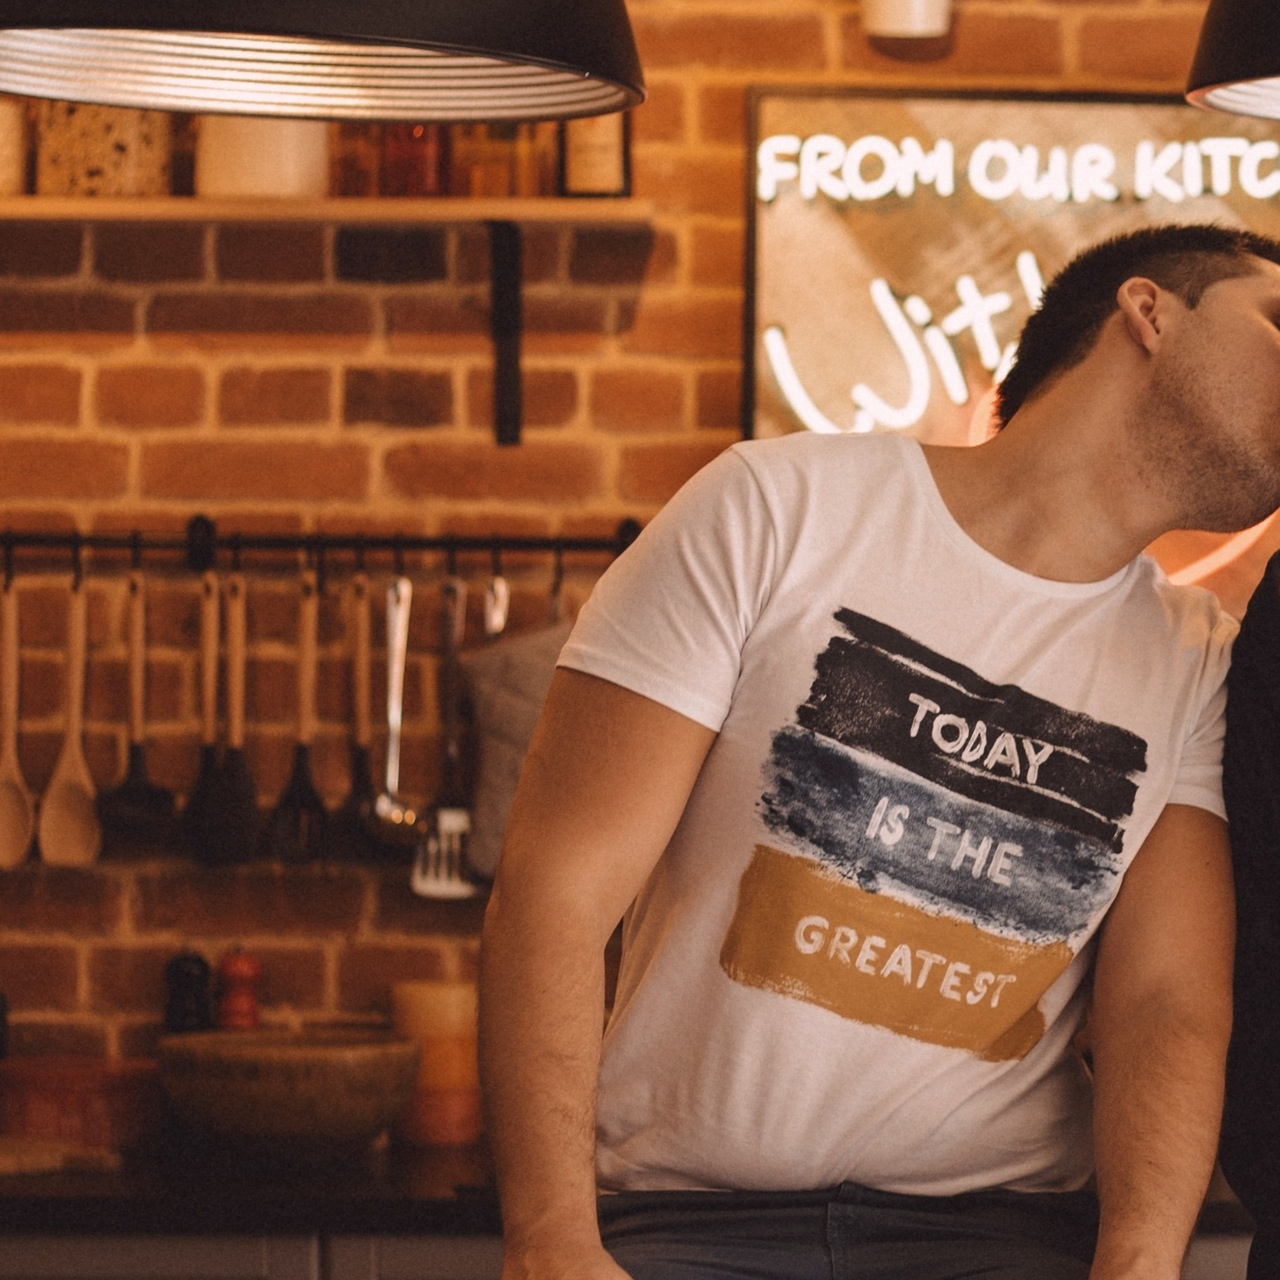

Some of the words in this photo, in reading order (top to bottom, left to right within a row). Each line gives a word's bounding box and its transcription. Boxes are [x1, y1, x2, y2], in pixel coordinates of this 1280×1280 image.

[757, 134, 954, 201] FROM
[967, 138, 1117, 202] OUR
[907, 692, 1054, 785] TODAY
[864, 796, 910, 846] IS
[926, 816, 1024, 887] THE
[794, 915, 1017, 1008] GREATEST
